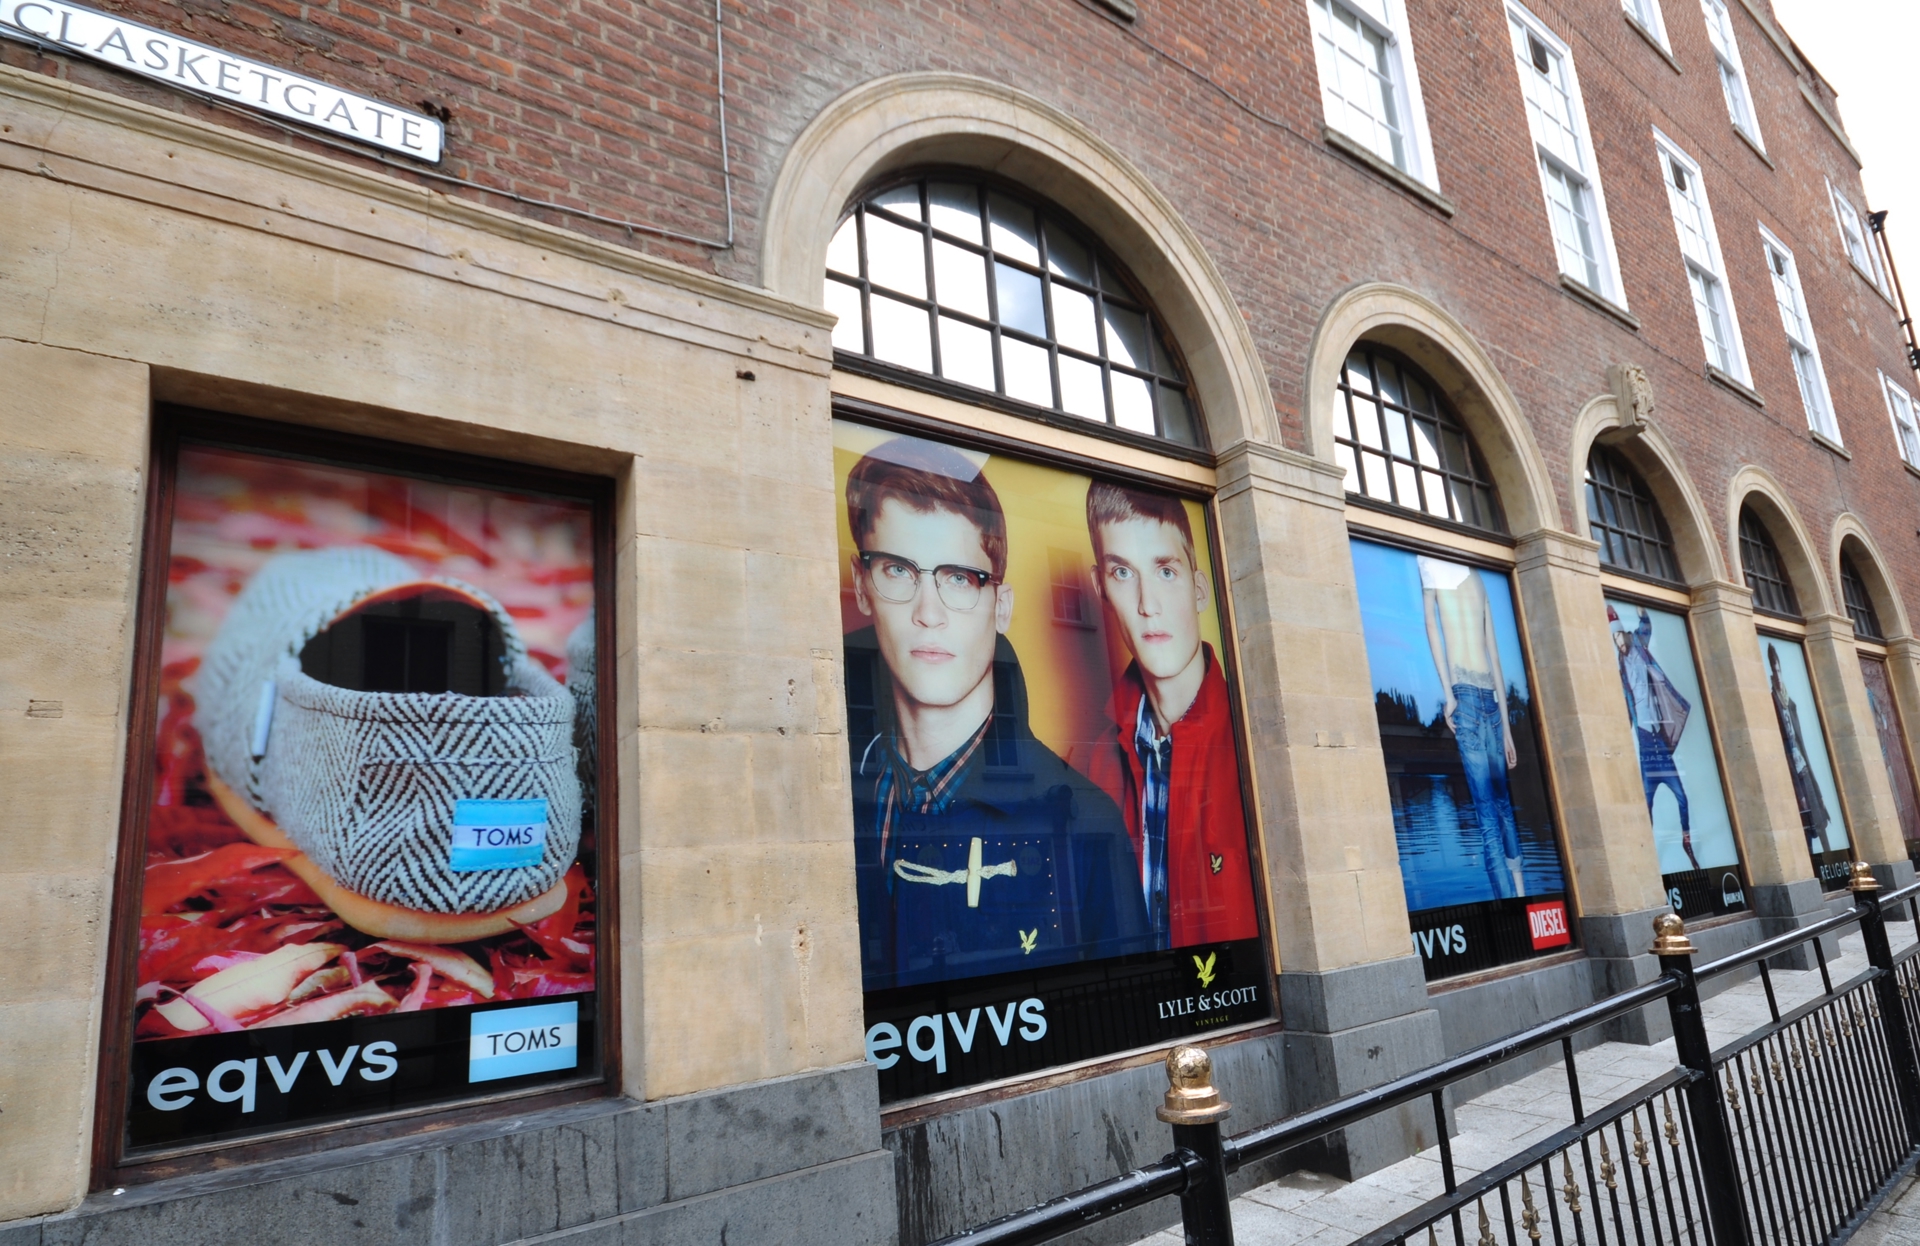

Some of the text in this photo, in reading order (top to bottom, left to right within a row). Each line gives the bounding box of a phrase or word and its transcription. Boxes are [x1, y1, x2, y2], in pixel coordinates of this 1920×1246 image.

[13, 2, 423, 151] CLASKETGATE
[472, 827, 533, 848] TOMS
[1530, 908, 1567, 938] DIESEL
[1158, 986, 1257, 1019] LYLE & SCOTT
[865, 998, 1047, 1074] eqvvs
[1195, 1015, 1229, 1027] VINTAGE
[487, 1026, 561, 1056] TOMS
[146, 1040, 399, 1113] eqvvs
